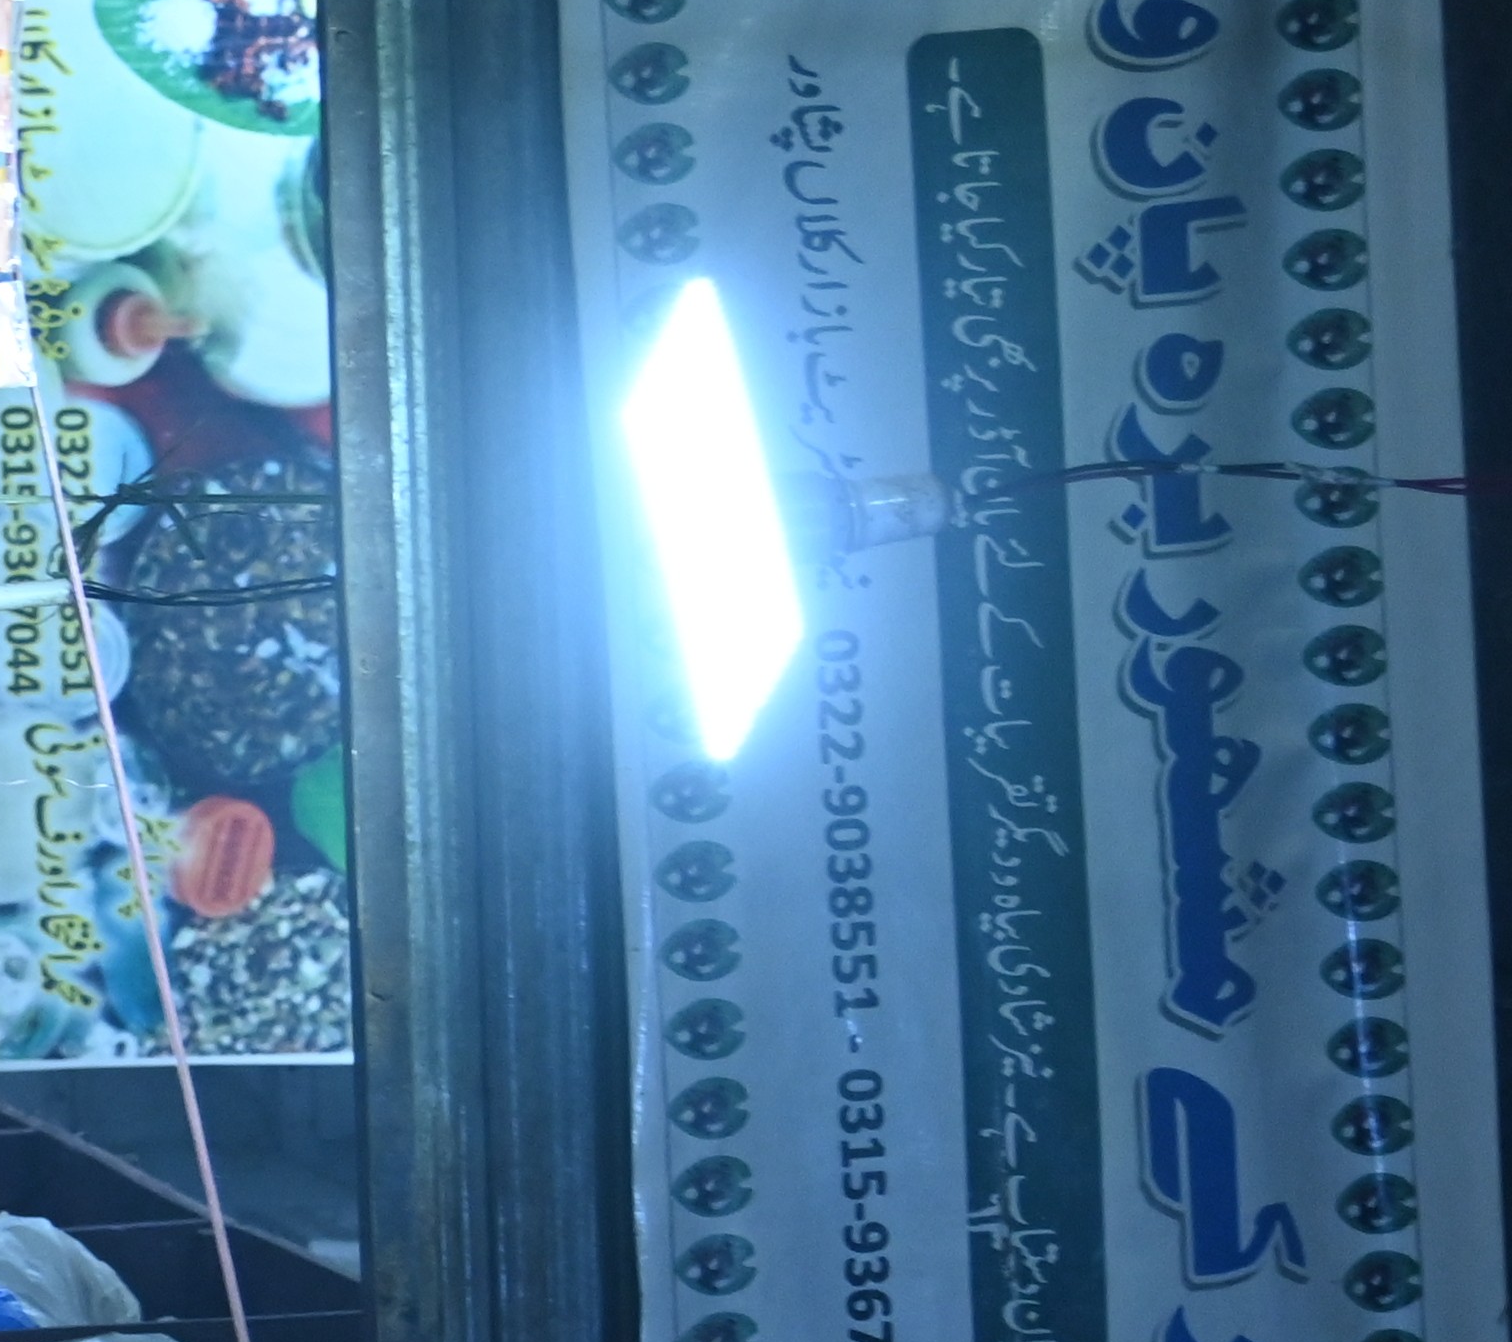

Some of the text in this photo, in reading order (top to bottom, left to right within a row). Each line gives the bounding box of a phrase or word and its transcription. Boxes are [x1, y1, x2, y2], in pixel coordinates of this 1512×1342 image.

[768, 54, 845, 154] پشاور
[1080, 97, 1247, 304] پان
[54, 408, 94, 696] 0322-8551
[816, 629, 882, 1020] 0322-9038551
[1138, 1068, 1306, 1279] کے
